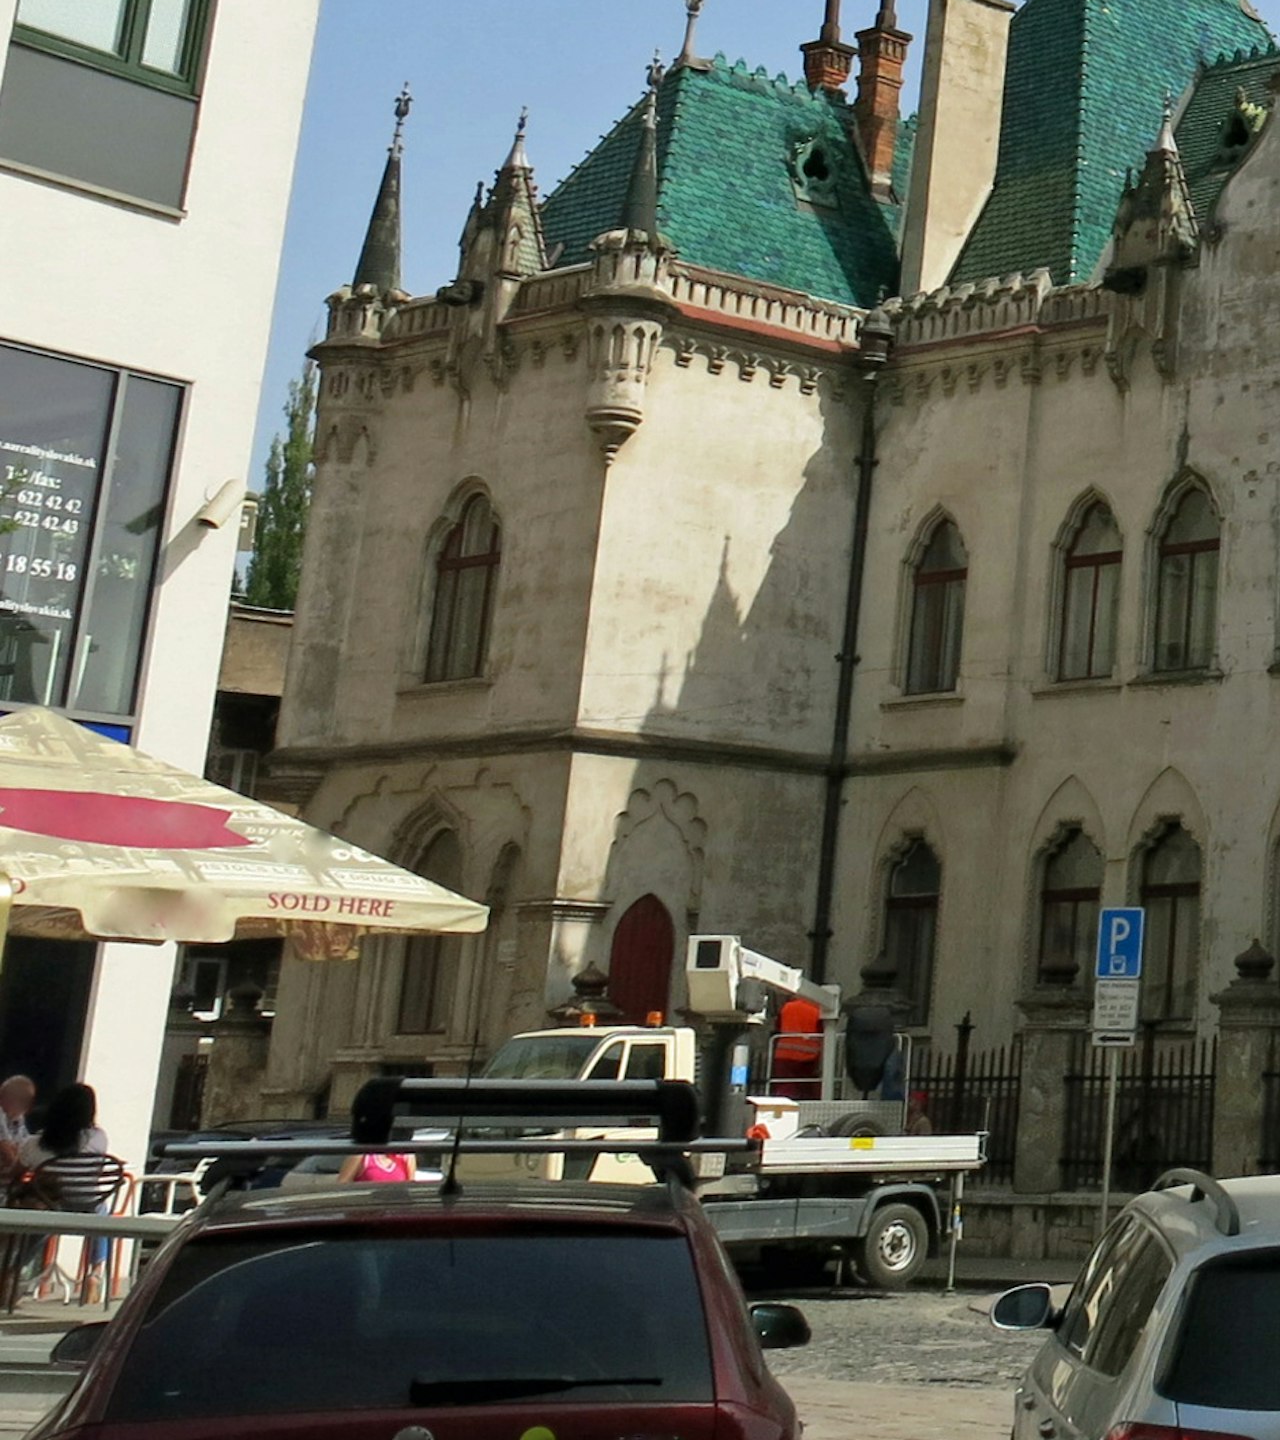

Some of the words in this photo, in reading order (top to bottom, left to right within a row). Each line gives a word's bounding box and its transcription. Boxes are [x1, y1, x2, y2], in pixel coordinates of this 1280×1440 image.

[17, 489, 43, 507] 622
[45, 495, 63, 510] 42
[65, 499, 82, 514] 42
[13, 510, 40, 528] 622
[41, 515, 60, 531] 42
[61, 518, 79, 534] 43
[6, 554, 28, 574] 18
[30, 558, 52, 578] 55
[56, 562, 77, 582] 18
[267, 892, 331, 913] SOLD
[338, 896, 396, 918] HERE
[1110, 917, 1130, 954] P
